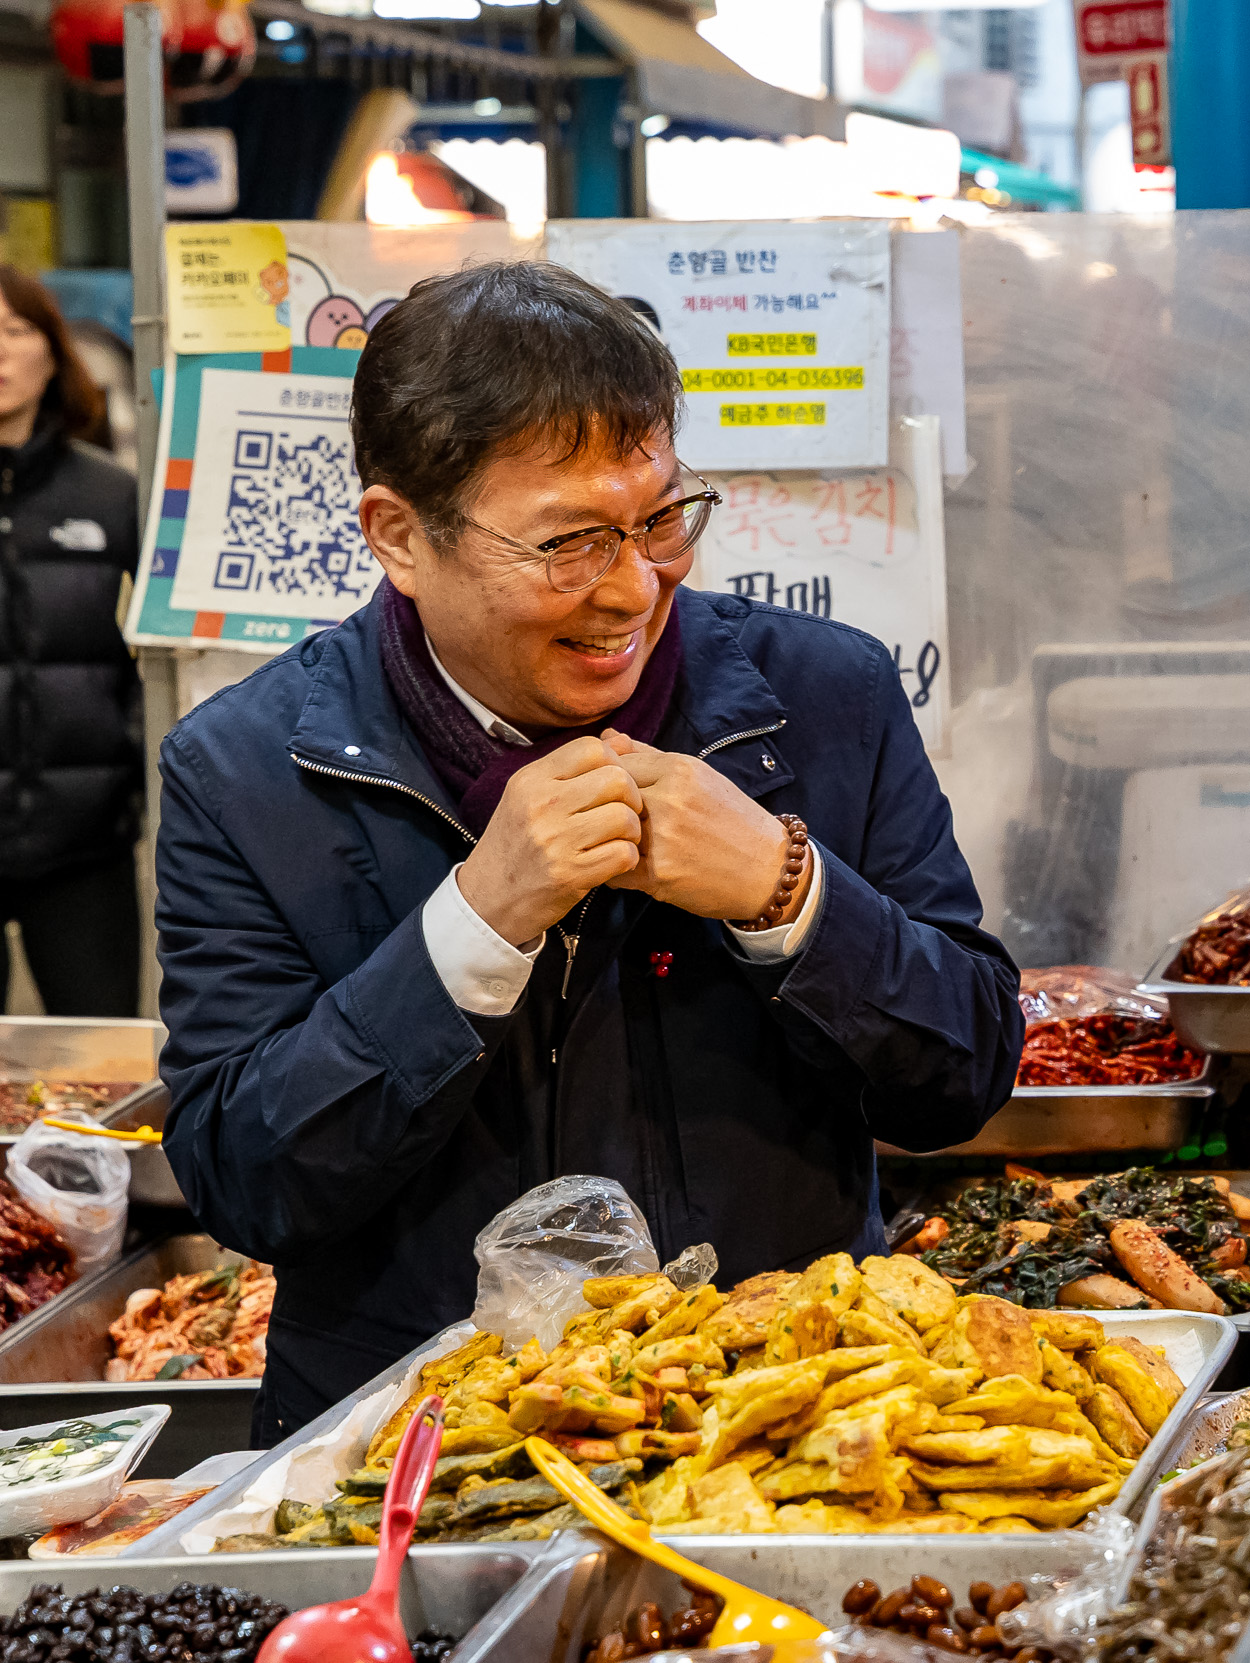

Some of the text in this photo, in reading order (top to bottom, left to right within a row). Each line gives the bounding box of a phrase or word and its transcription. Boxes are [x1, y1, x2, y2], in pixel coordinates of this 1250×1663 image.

[736, 249, 777, 274] 반찬
[683, 294, 748, 312] 계좌이체
[727, 333, 817, 354] KB국민은행
[720, 404, 768, 424] 예금주
[243, 619, 291, 639] zero
